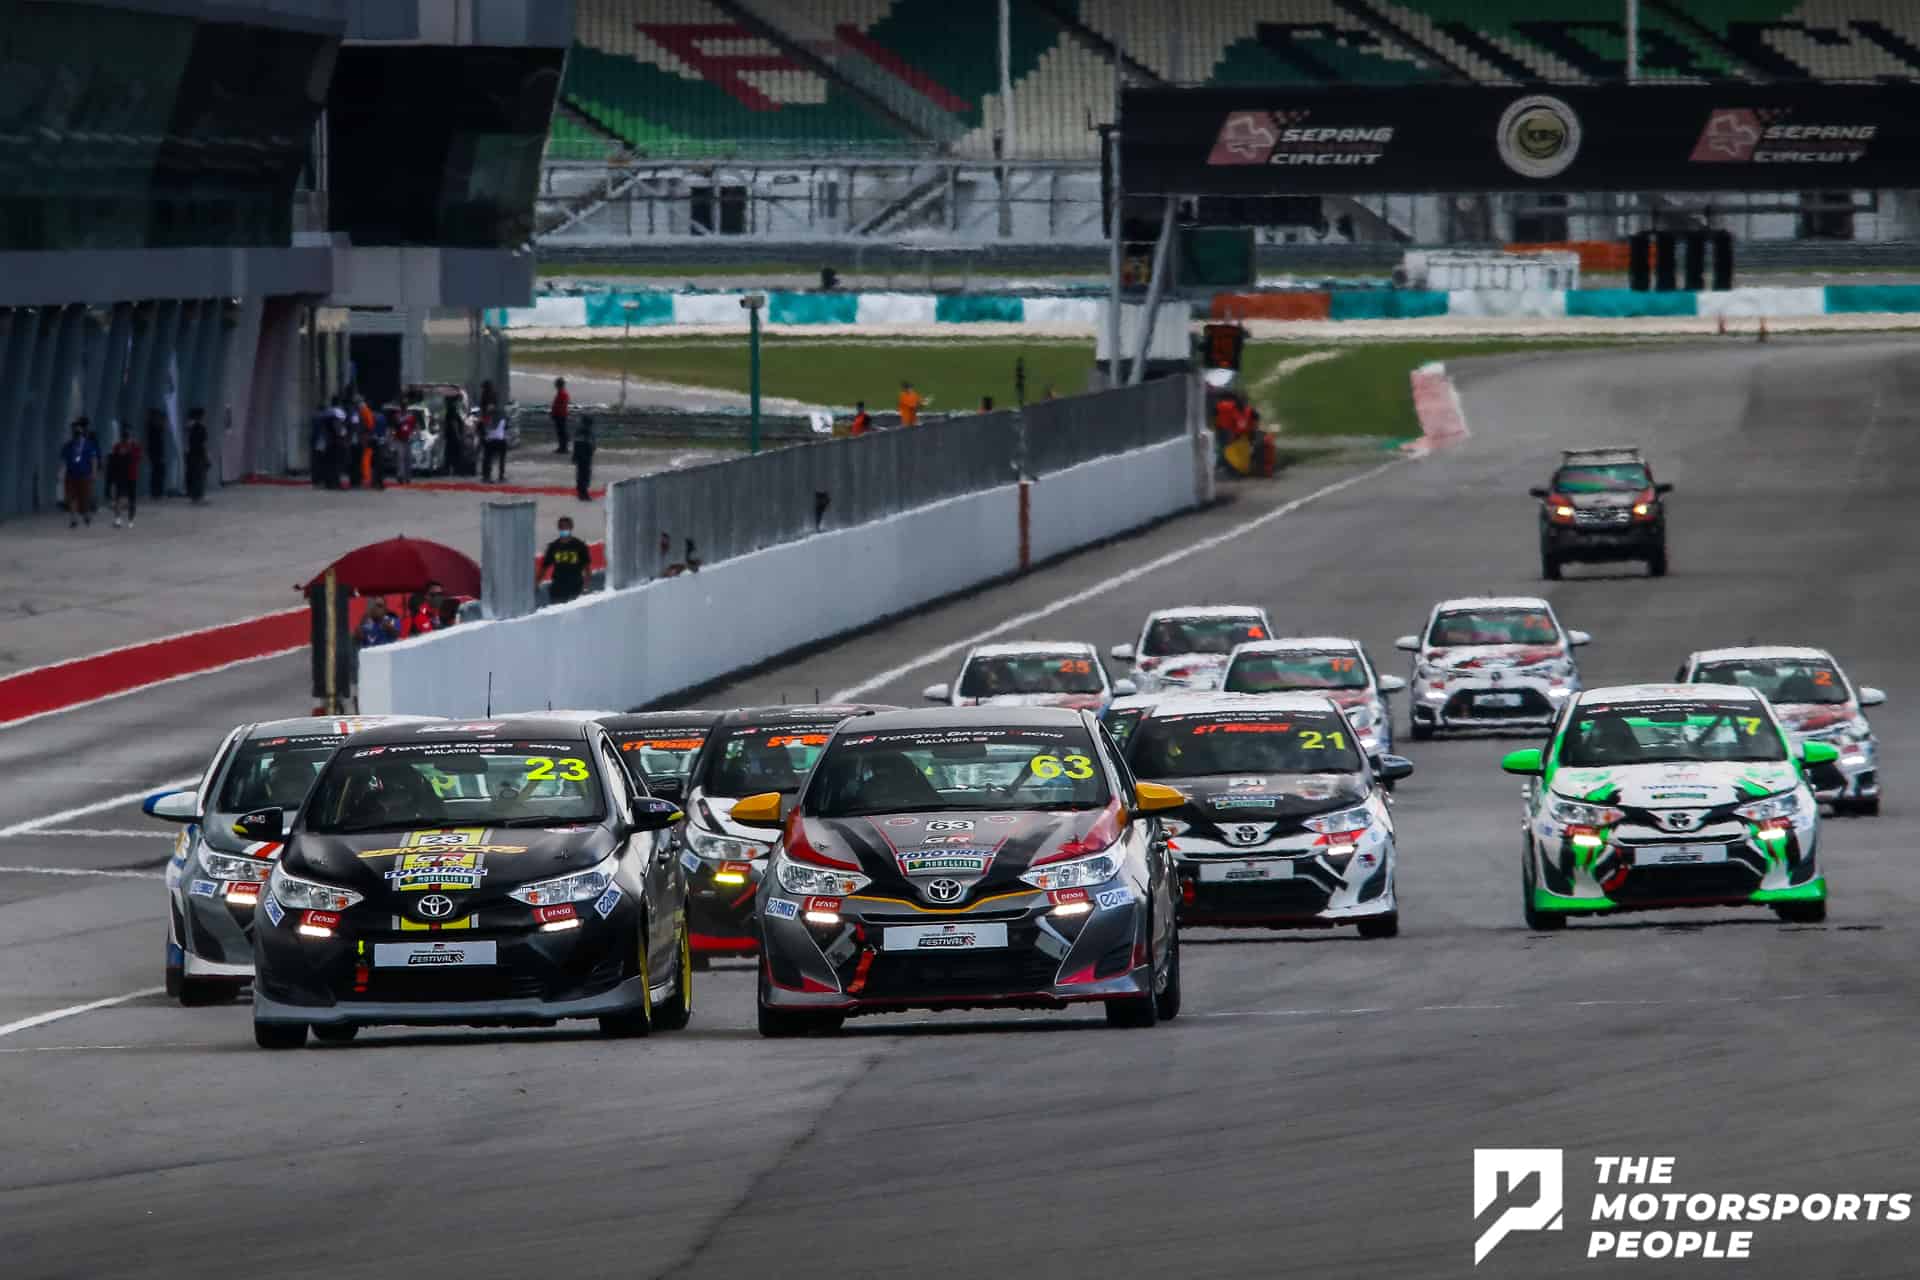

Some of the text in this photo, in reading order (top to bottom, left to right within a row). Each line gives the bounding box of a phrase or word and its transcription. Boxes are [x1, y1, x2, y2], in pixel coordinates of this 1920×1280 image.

[1281, 127, 1394, 142] SEPANG
[1764, 126, 1877, 139] SEPANG
[1270, 153, 1383, 165] CIRCUIT
[1753, 151, 1864, 163] CIRCUIT
[1815, 672, 1833, 688] 2
[1743, 717, 1761, 736] 7
[879, 732, 942, 742] TOYOTA
[916, 736, 970, 745] MALAYSIA
[1298, 731, 1345, 749] 21
[424, 748, 479, 756] MALAYSIA
[525, 758, 590, 781] 23
[1030, 754, 1094, 779] 63
[930, 821, 969, 831] 63
[425, 835, 463, 844] 23
[547, 908, 571, 917] DENSO
